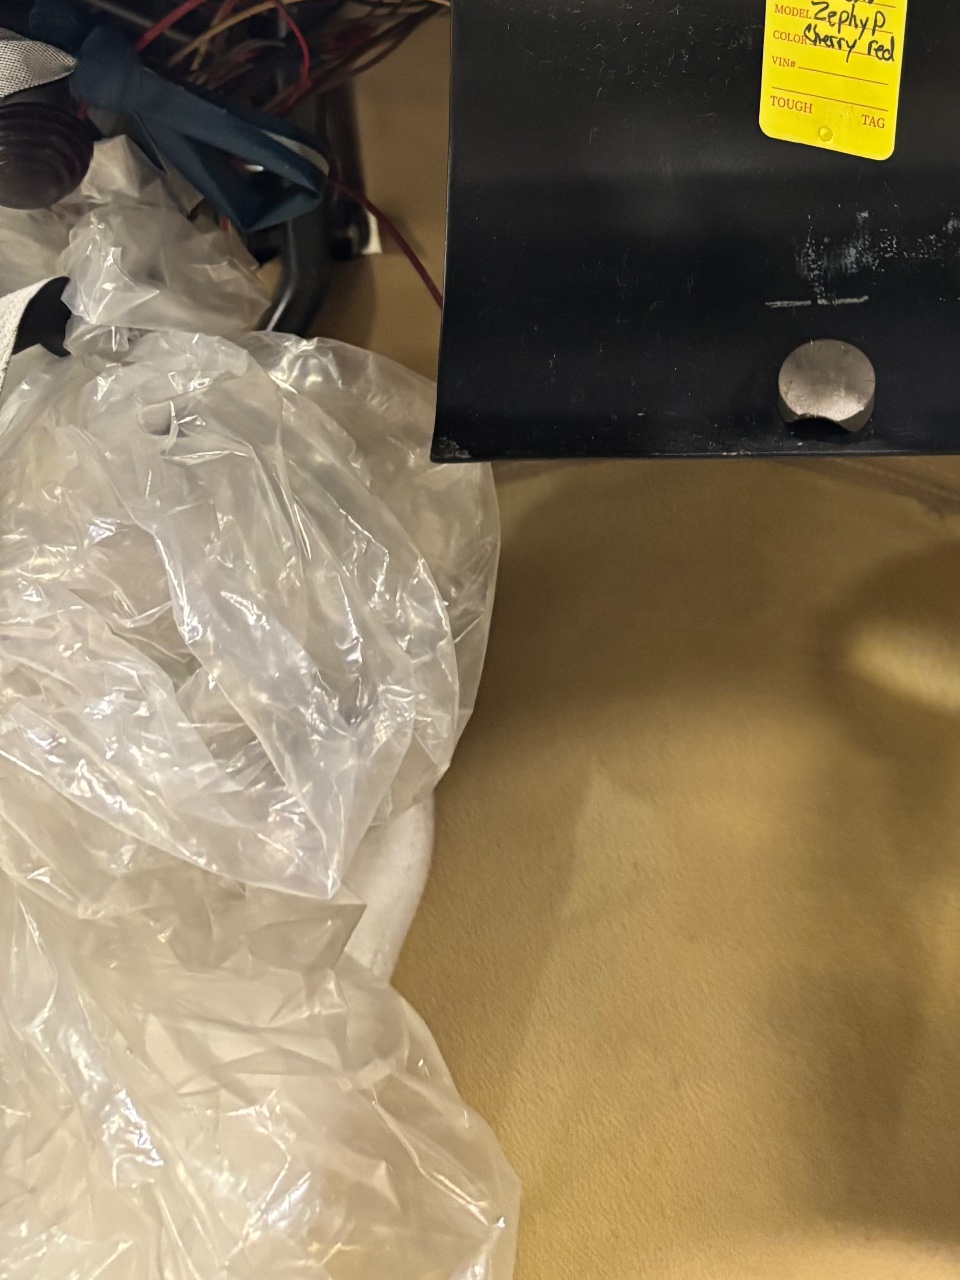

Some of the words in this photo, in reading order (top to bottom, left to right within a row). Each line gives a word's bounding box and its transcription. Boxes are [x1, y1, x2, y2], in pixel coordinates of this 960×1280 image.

[774, 4, 812, 19] MODEL
[773, 30, 808, 45] COLOR
[868, 36, 895, 62] red
[771, 56, 796, 69] VIN#
[770, 95, 813, 114] TOUGH
[861, 114, 885, 129] TAG
